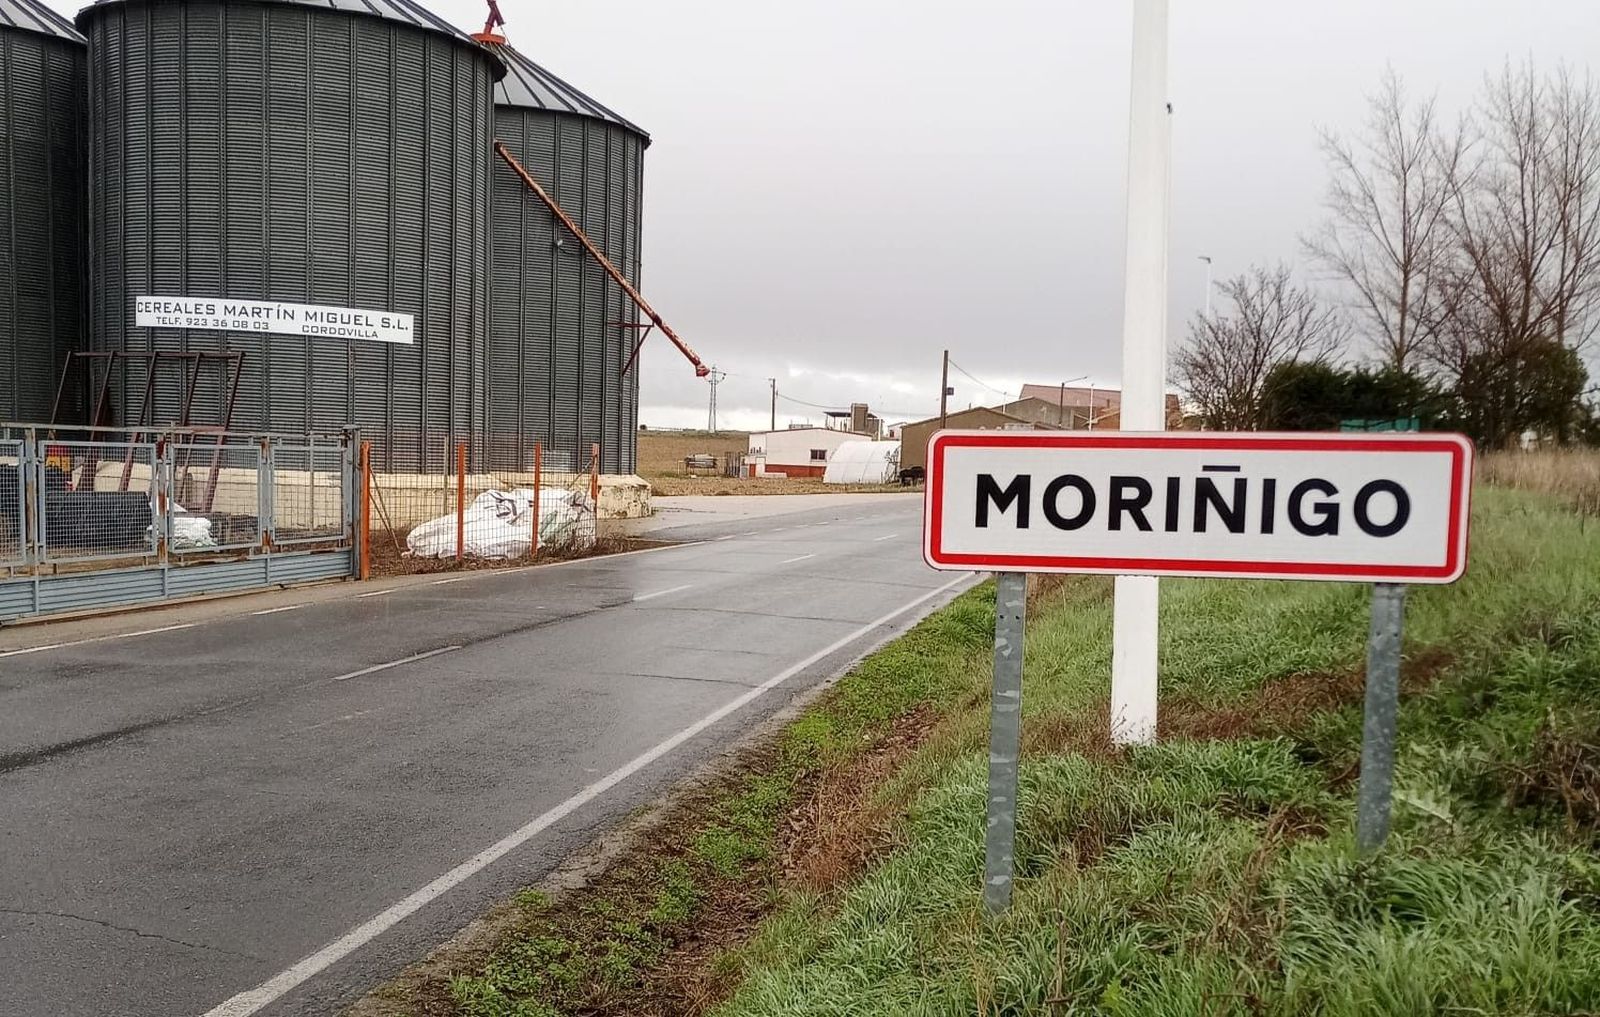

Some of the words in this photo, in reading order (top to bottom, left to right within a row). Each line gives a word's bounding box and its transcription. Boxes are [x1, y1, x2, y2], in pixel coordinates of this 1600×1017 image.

[137, 301, 216, 315] CEREALES
[223, 304, 295, 320] MARTÍN
[305, 311, 374, 327] MIGUEL
[380, 317, 409, 331] S.L.
[156, 316, 182, 325] TELF.
[186, 318, 208, 327] 923
[213, 319, 228, 328] 36
[232, 320, 249, 329] 08
[253, 321, 269, 330] 03
[302, 324, 378, 338] CORDOVILLA
[975, 464, 1412, 538] MORIÑIGO
